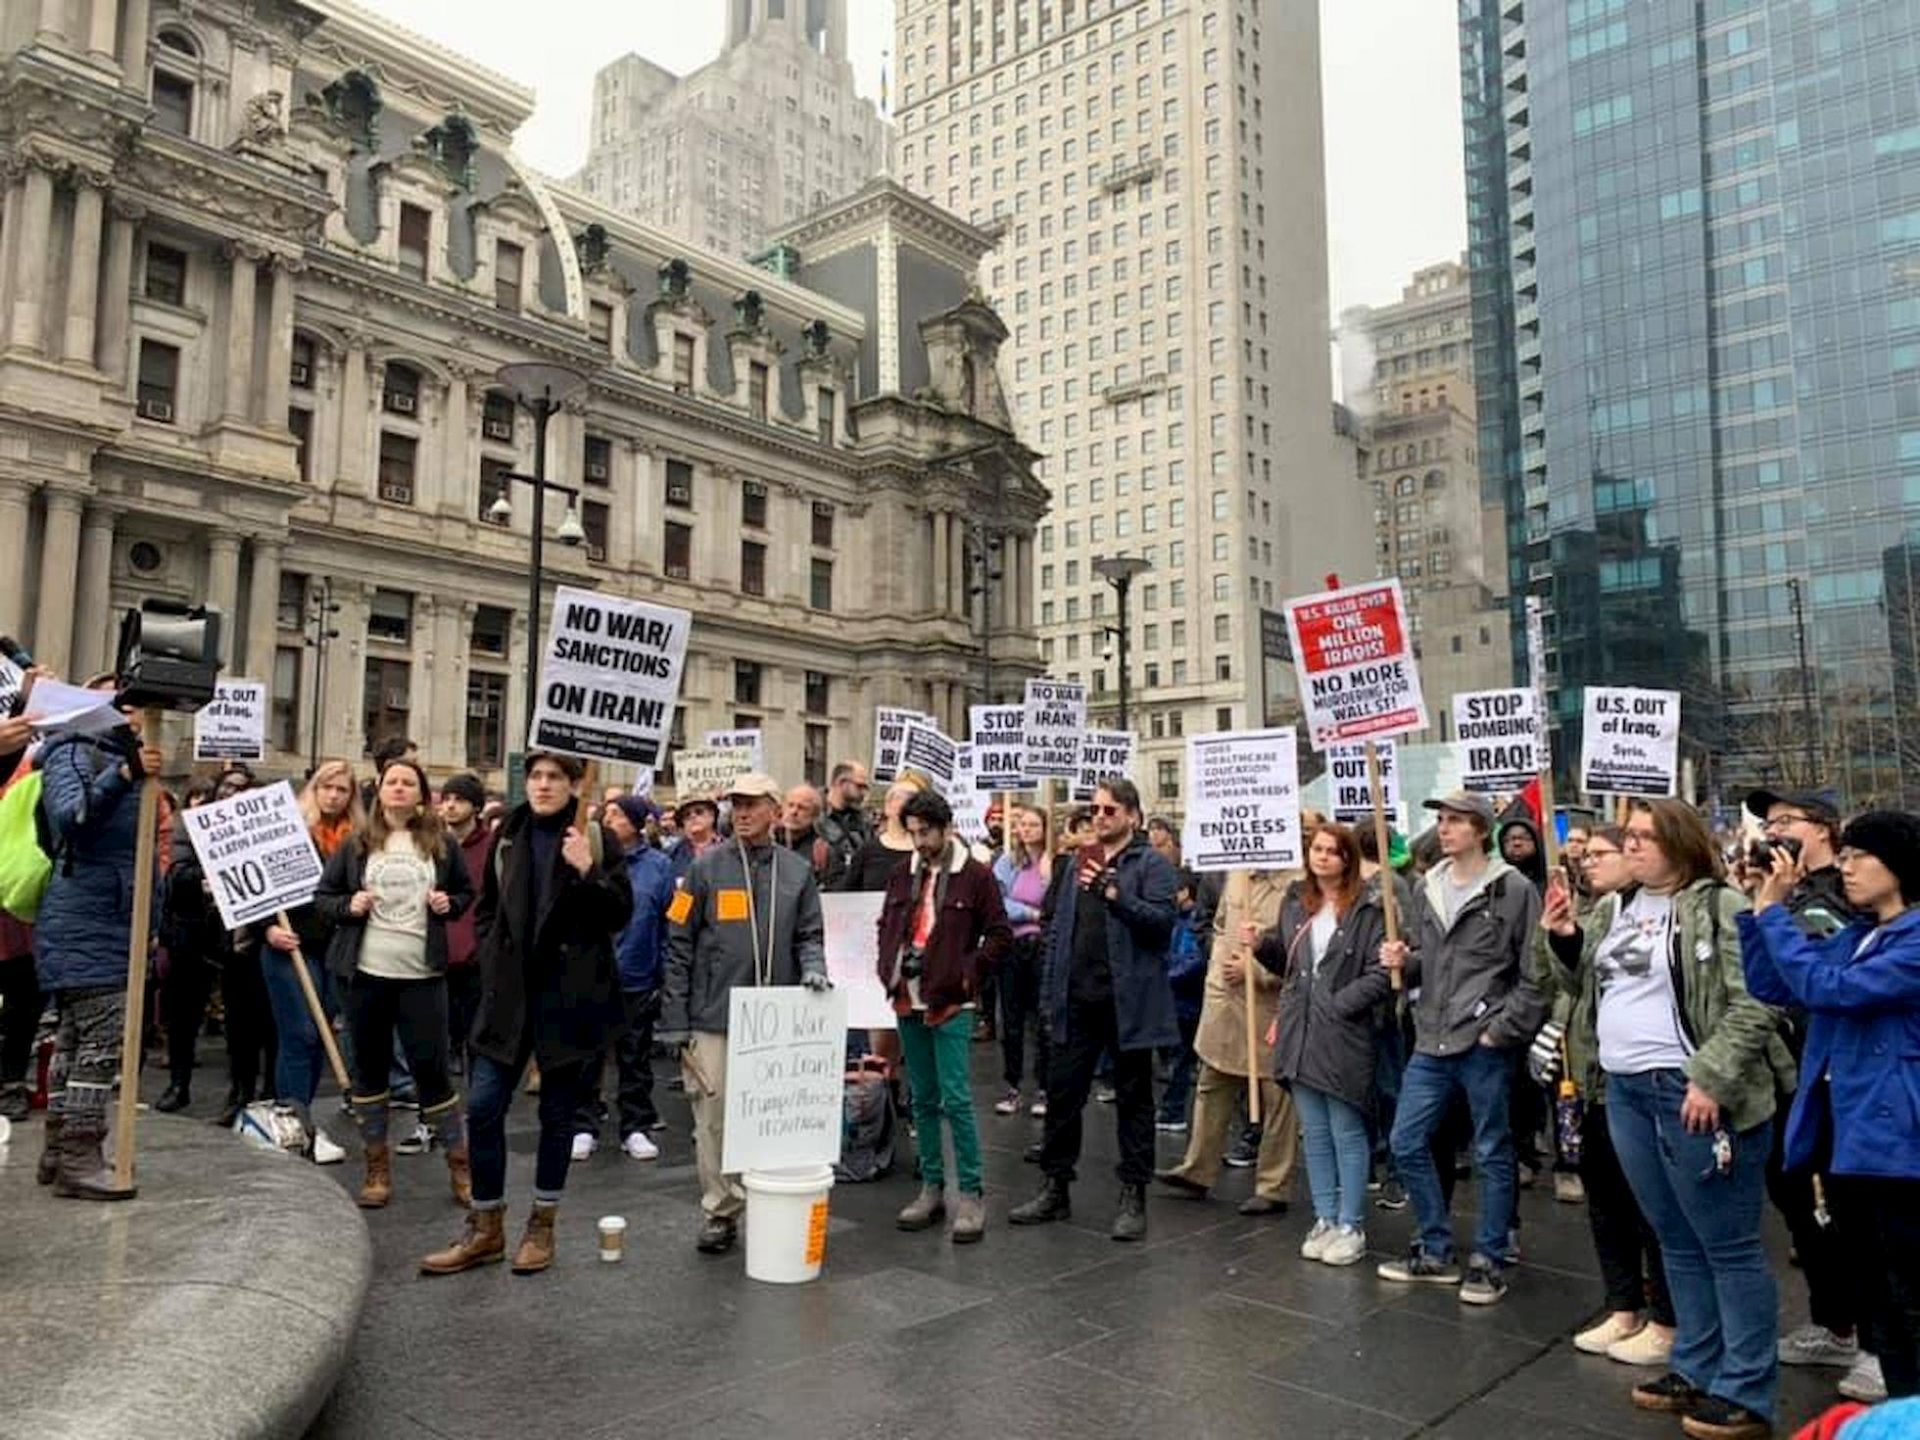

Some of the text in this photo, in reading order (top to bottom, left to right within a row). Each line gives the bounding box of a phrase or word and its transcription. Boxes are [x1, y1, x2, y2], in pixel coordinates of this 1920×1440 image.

[566, 604, 672, 652] NO WAR/
[1332, 611, 1366, 630] ONE
[1319, 624, 1384, 650] MILLION
[554, 637, 671, 678] SANCTIONS
[1325, 640, 1386, 666] IRAQIS!
[1312, 662, 1404, 696] NO MORE
[232, 689, 256, 702] OUT
[1032, 687, 1083, 701] NO WAR
[1313, 680, 1409, 712] MURDERING FOR
[209, 703, 221, 716] of
[547, 682, 664, 728] ON IRAN!
[1332, 696, 1396, 721] WALL ST!
[1467, 694, 1523, 719] STOP
[1596, 696, 1667, 716] U.S. OUT
[1035, 711, 1077, 728] IRAN!
[1459, 717, 1536, 740] BOMBING
[1601, 716, 1661, 738] of Iraq,
[1027, 735, 1079, 750] U.S. OUT
[1043, 751, 1076, 765] IRAQ!
[1109, 749, 1128, 765] OF
[1204, 752, 1277, 765] HEALTHCARE
[1469, 744, 1533, 772] IRAQ!
[1204, 764, 1271, 776] EDUCATION
[1333, 759, 1365, 778] OUT
[1204, 776, 1258, 788] HOUSING
[1205, 784, 1290, 799] HUMAN NEEDS
[1340, 785, 1389, 806] IRA!
[197, 808, 232, 830] U.S.
[236, 796, 268, 817] OUT
[1221, 804, 1262, 819] NOT
[1200, 818, 1286, 838] ENDLESS
[220, 838, 250, 857] LATIN
[1221, 836, 1265, 851] WAR
[218, 861, 265, 905] NO
[738, 1001, 825, 1045] NO War
